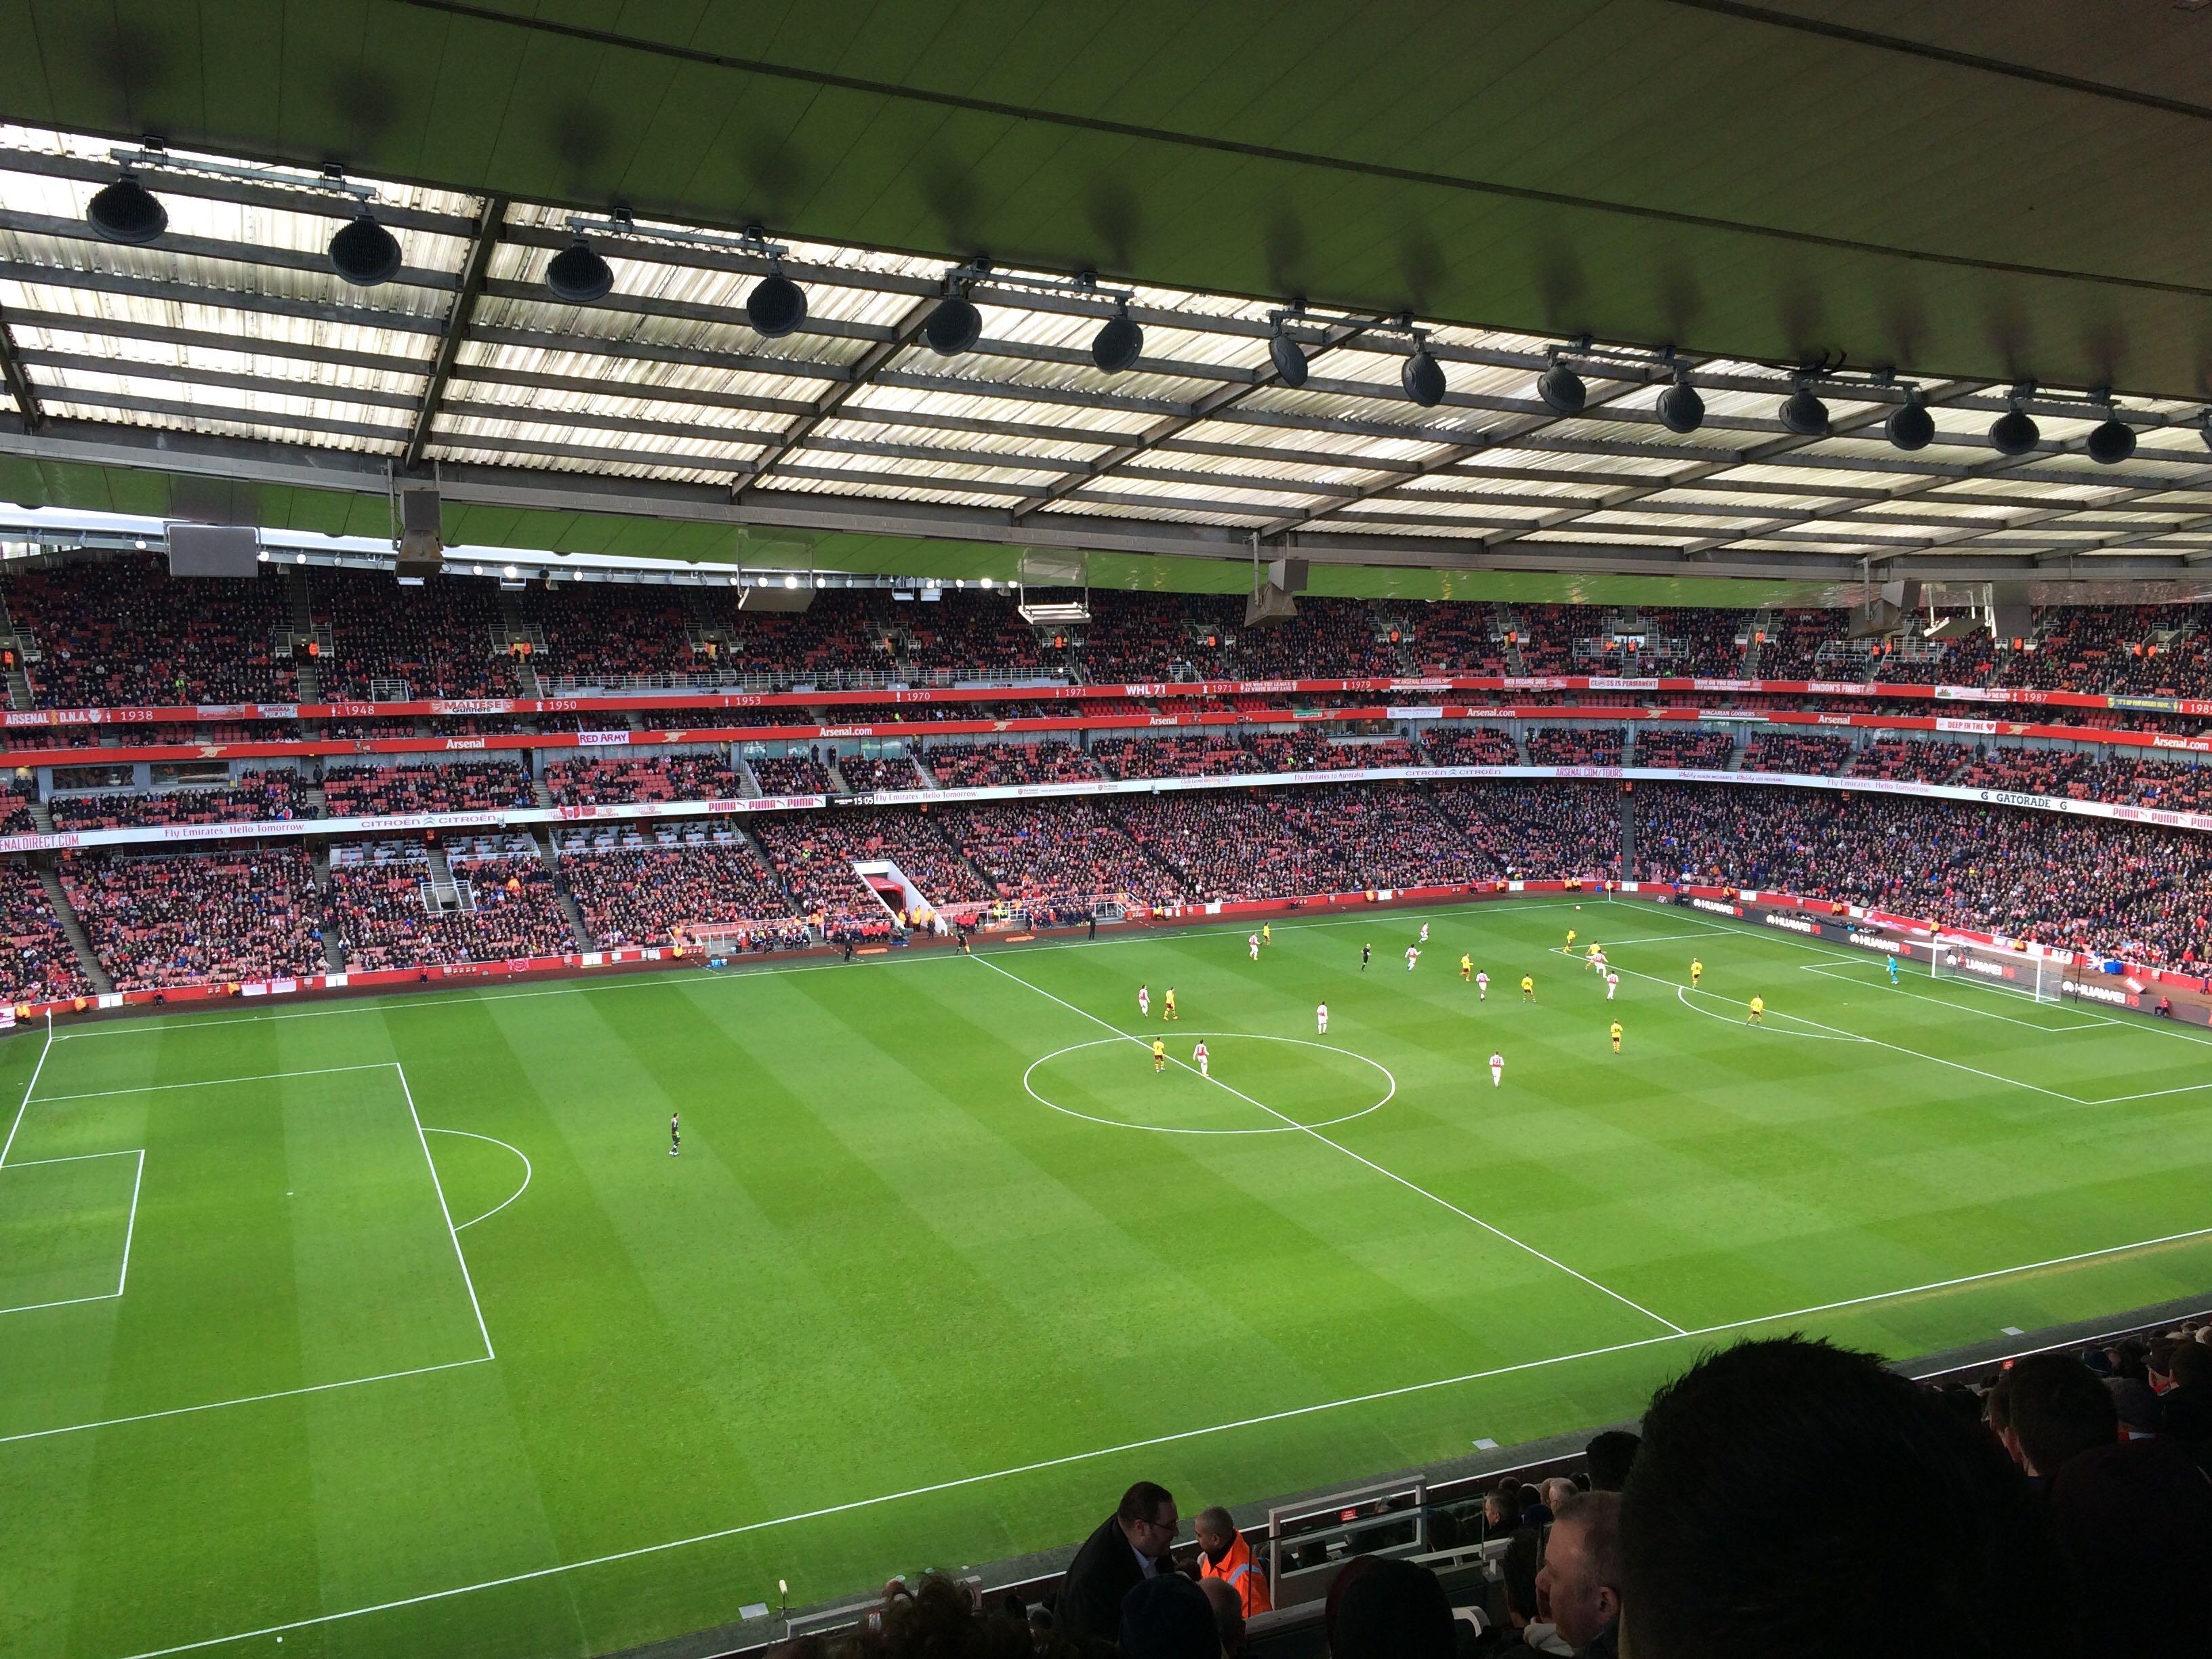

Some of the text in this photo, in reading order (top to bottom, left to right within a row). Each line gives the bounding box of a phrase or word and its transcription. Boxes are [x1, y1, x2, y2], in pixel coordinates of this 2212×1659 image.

[1065, 689, 1086, 697] 1971
[1126, 685, 1166, 695] WHL 71
[1212, 684, 1232, 693] 1971
[1808, 683, 1865, 693] LONDON'S FINEST
[737, 697, 761, 705] 1953
[907, 692, 930, 701] 1970
[2024, 693, 2047, 702] 1987
[444, 700, 502, 710] MALTESE
[550, 701, 577, 710] 1950
[121, 710, 153, 721] 1938
[346, 705, 375, 716] 1948
[1467, 708, 1515, 718] Arsenal.com
[6, 711, 88, 725] ARSENAL D.N.A.
[1150, 716, 1178, 726] Arsenal
[1818, 714, 1851, 725] Arsenal
[1947, 721, 1984, 730] DEEP IN THE
[819, 726, 873, 737] Arsenal.com
[579, 733, 626, 743] RED ARMY
[446, 738, 485, 750] Arsenal
[2153, 736, 2209, 751] Arsenal.com
[1555, 768, 1623, 777] ARSENAL.COM/TOURS
[1828, 779, 1838, 787] Fly
[1875, 781, 1893, 790] Hello
[787, 798, 814, 808] PUMA
[853, 796, 873, 805] 15:05
[876, 795, 887, 804] Fly
[1981, 791, 2068, 810] G GATORADE G
[708, 801, 736, 812] PUMA
[749, 800, 776, 810] PUMA
[2113, 807, 2139, 819] PUMA
[361, 817, 420, 828] CITROËN
[438, 815, 497, 825] CITROËN
[2152, 813, 2179, 824] PUMA
[165, 829, 180, 838] Fly
[230, 825, 253, 834] Hello
[1701, 900, 1743, 917] HUAWEI P8
[1775, 916, 1822, 935] HUAWEI P8
[1860, 935, 1911, 954] HUAWEI P8
[1959, 957, 2003, 976] UAWEI
[2074, 983, 2126, 1004] HUAWEI
[2127, 994, 2139, 1007] P8
